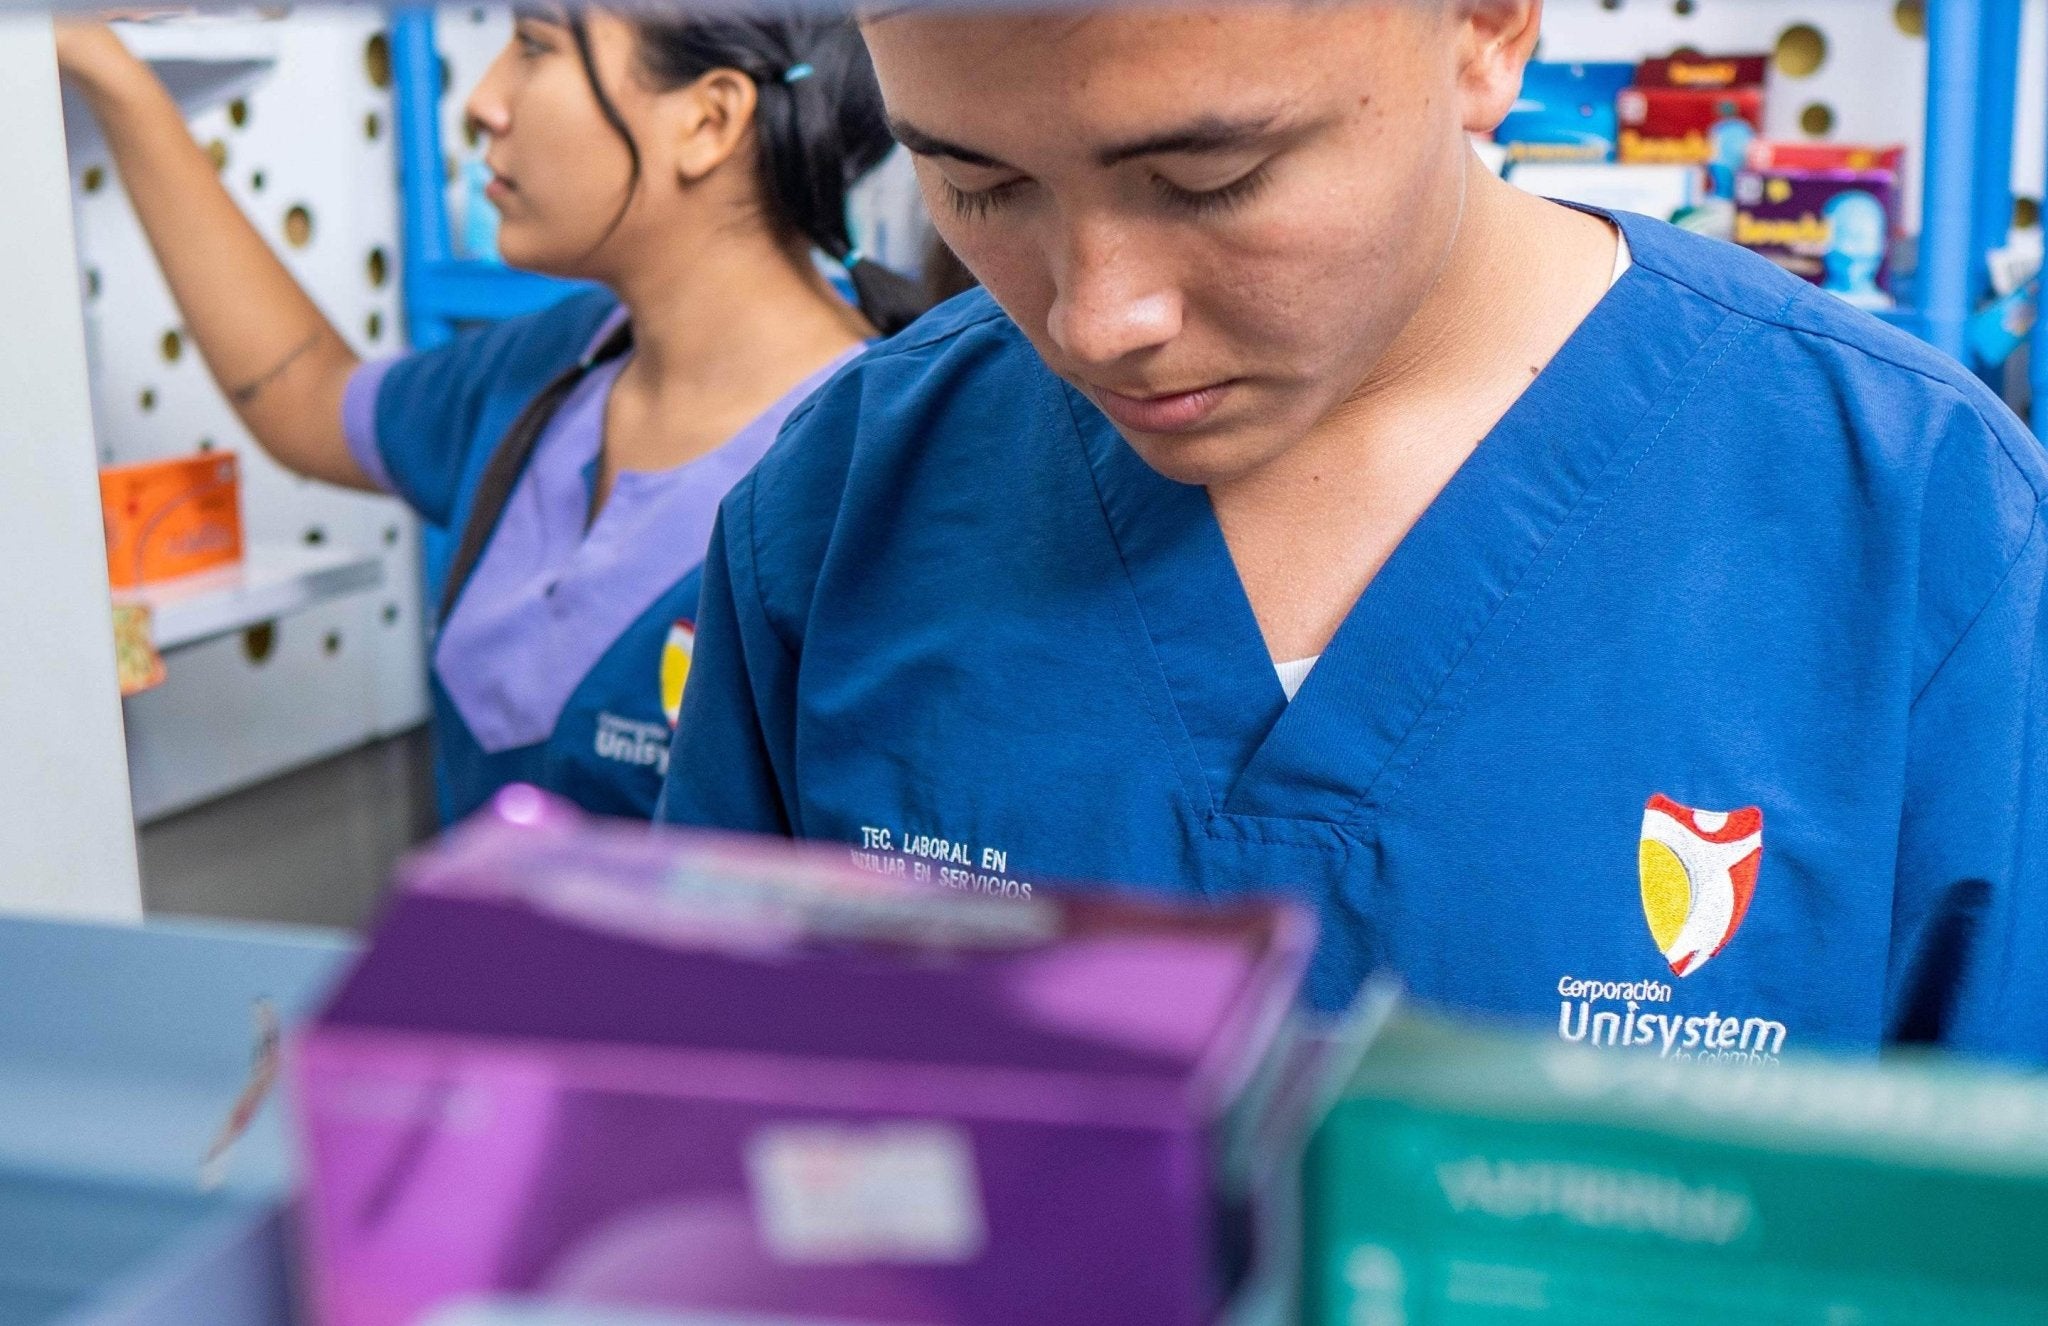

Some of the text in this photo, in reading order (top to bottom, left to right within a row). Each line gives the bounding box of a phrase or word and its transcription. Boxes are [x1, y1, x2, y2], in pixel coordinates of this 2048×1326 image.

[861, 826, 1007, 873] TEC. LABORAL EN
[913, 861, 931, 883] EN
[938, 866, 1033, 901] SERVICIOS
[1558, 975, 1672, 1003] Corporación
[1558, 1000, 1787, 1060] Unisystem
